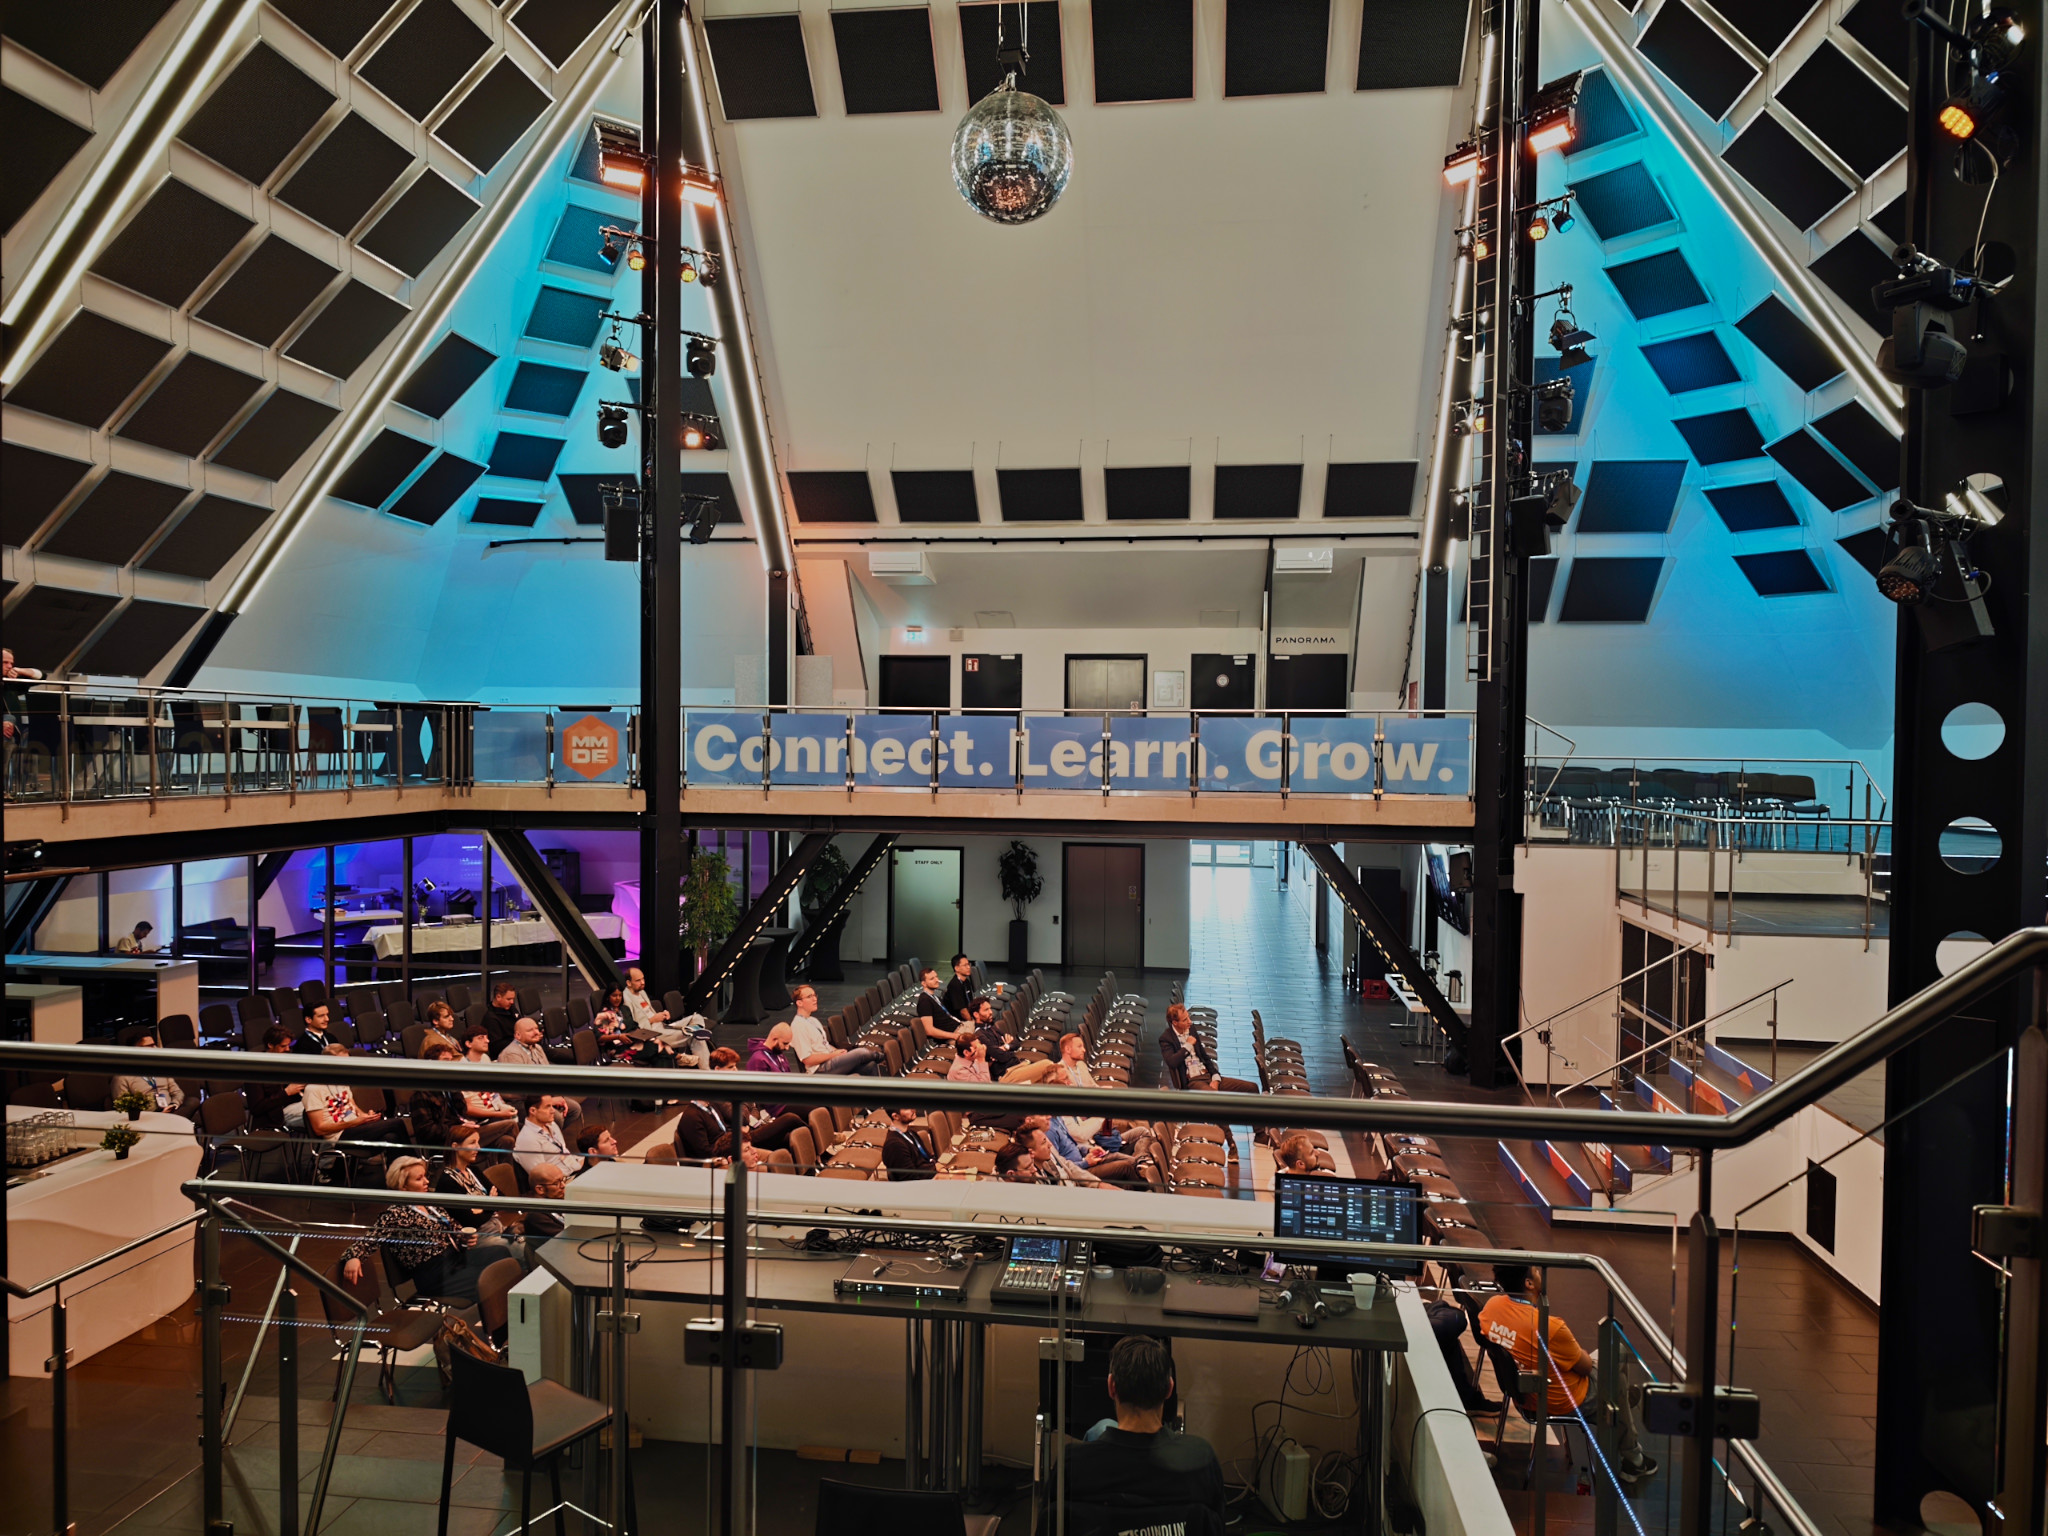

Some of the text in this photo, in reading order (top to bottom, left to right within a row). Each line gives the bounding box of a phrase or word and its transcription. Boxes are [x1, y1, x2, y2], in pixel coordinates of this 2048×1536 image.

[572, 736, 608, 747] MM
[572, 749, 608, 764] DE
[693, 723, 1454, 783] Connect. Learn. Grow.
[1490, 1320, 1516, 1341] MM
